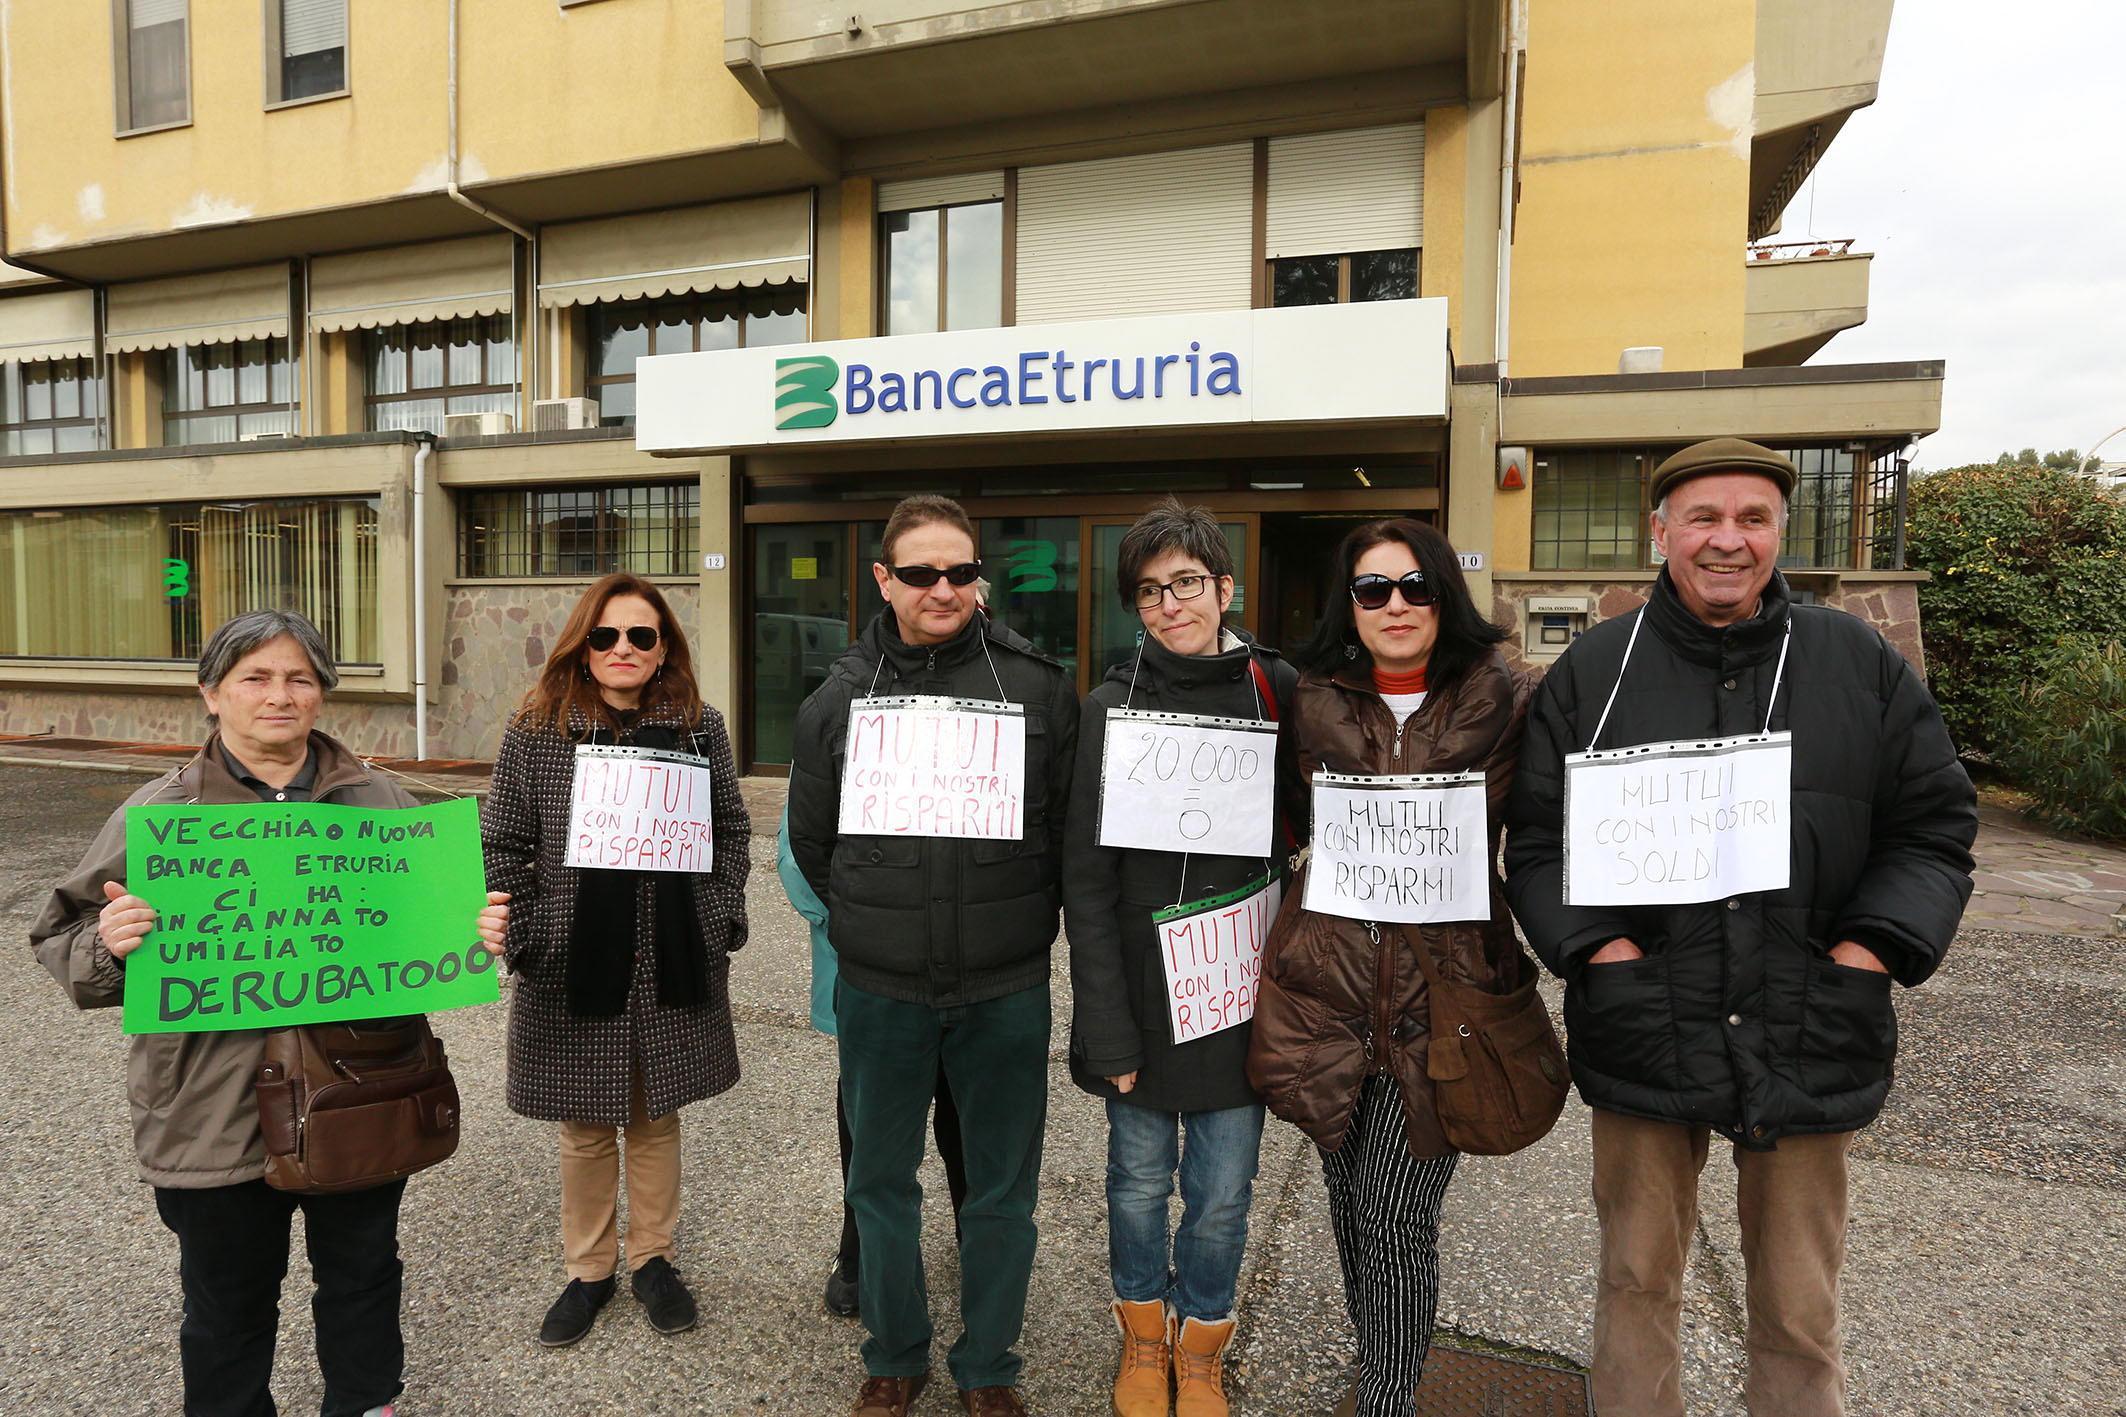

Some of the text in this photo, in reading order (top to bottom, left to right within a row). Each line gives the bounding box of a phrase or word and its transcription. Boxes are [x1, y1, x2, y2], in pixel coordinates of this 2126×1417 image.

[846, 341, 1242, 415] BancaEtruria
[709, 557, 720, 567] 12
[1461, 556, 1478, 567] 10
[853, 714, 1000, 772] MUTUI
[581, 761, 694, 814] MUTUI
[855, 768, 897, 788] CON
[933, 773, 1009, 796] NOSTRI
[1623, 762, 1735, 809] MUTUI
[357, 819, 436, 845] NUOVA
[583, 809, 621, 830] CON
[652, 817, 712, 844] NOSTRI
[862, 791, 1017, 838] RISPARMI
[1348, 799, 1443, 828] MUTUI
[1595, 815, 1656, 845] CON
[1690, 799, 1777, 835] NOSTRI
[577, 831, 702, 871] RISPARMI
[1323, 821, 1360, 852] CON
[1381, 826, 1460, 857] NOSTRI
[146, 853, 411, 881] BANCA ETRURIA
[1335, 861, 1454, 906] RISPARMI
[1616, 847, 1720, 886] SOLDI
[157, 940, 496, 1023] DERUBATOOO
[1174, 973, 1211, 1000] CON
